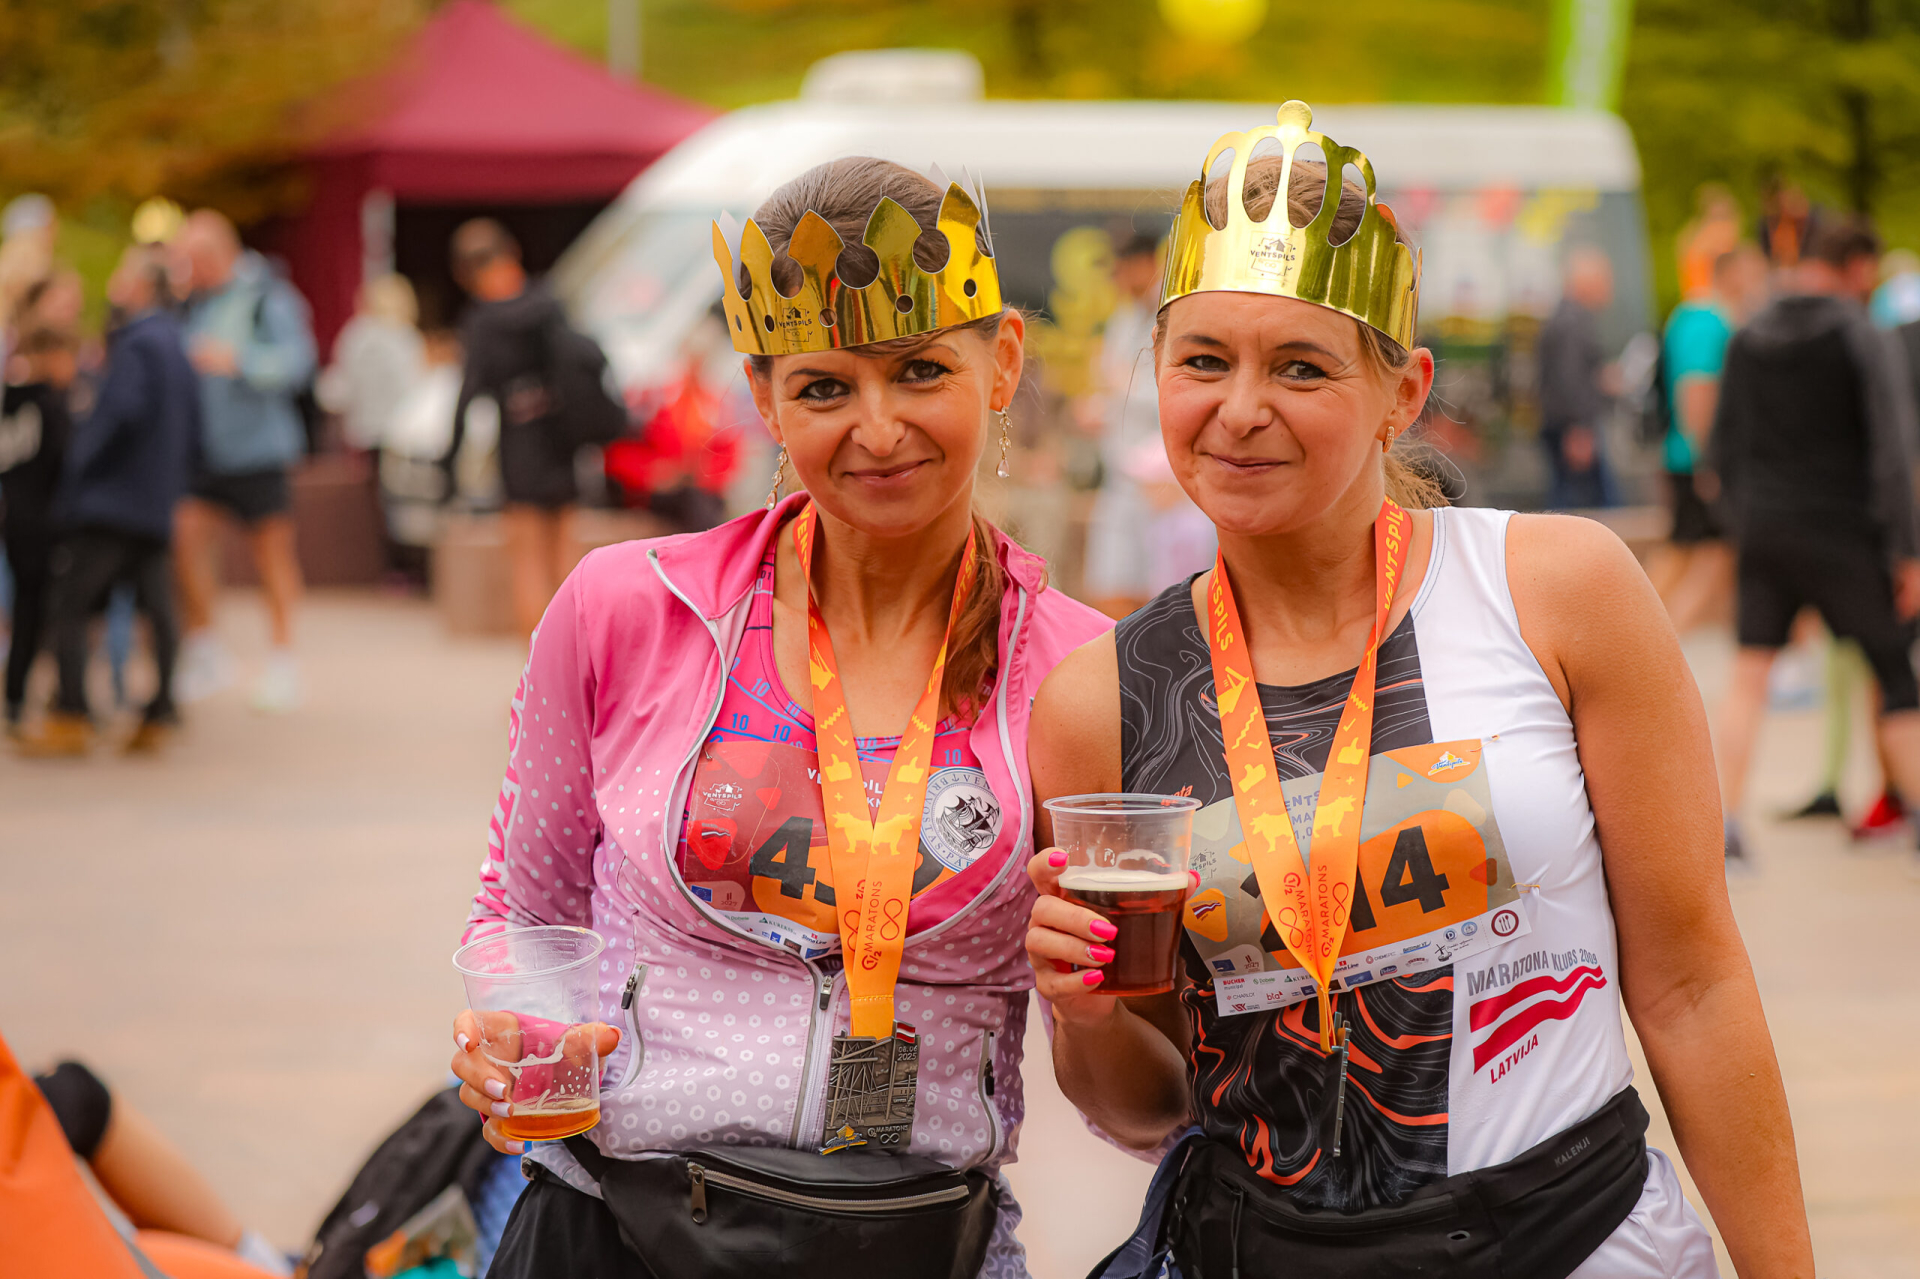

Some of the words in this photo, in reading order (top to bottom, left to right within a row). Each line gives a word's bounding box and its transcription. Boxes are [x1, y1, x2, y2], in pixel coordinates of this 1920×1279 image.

[1250, 250, 1296, 261] VENTSPILS
[779, 319, 813, 329] VENTSPILS
[732, 713, 749, 731] 10
[773, 724, 791, 742] 10
[944, 749, 961, 765] 10
[703, 791, 743, 800] VENTSPILS
[1318, 865, 1330, 938] MARATONS
[864, 881, 882, 952] MARATONS
[1295, 890, 1314, 961] MARATONS
[1466, 950, 1549, 996] MARATONA
[1551, 949, 1578, 972] KLUBS
[1579, 948, 1598, 965] 2009
[1490, 1034, 1539, 1085] LATVIJA
[1554, 1136, 1591, 1168] KALENJI
